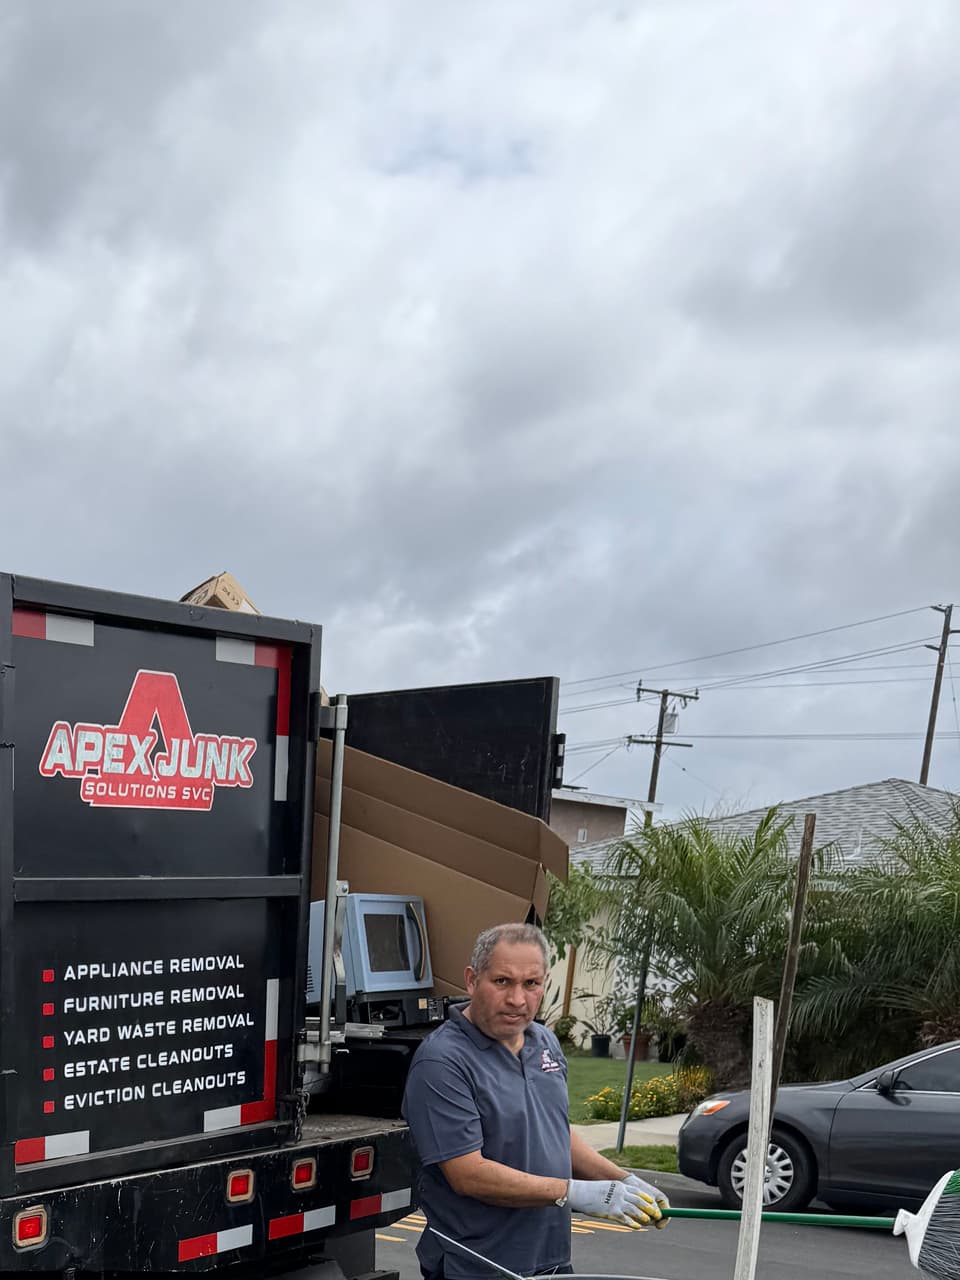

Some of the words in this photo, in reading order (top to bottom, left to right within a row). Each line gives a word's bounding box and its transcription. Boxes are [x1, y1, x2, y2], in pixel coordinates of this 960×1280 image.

[43, 728, 154, 775] APEX
[157, 737, 253, 781] JUNK
[84, 782, 177, 799] SOLUTIONS
[181, 786, 211, 801] SVC
[64, 959, 164, 981] APPLIANCE
[170, 955, 245, 974] REMOVAL
[64, 991, 164, 1013] FURNITURE
[170, 984, 245, 1004] REMOVAL
[64, 1027, 110, 1046] YARD
[118, 1021, 176, 1040] WASTE
[182, 1013, 255, 1033] REMOVAL
[64, 1056, 130, 1078] ESTATE
[137, 1044, 233, 1069] CLEANOUTS
[64, 1085, 145, 1110] EVICTION
[152, 1071, 246, 1097] CLEANOUTS
